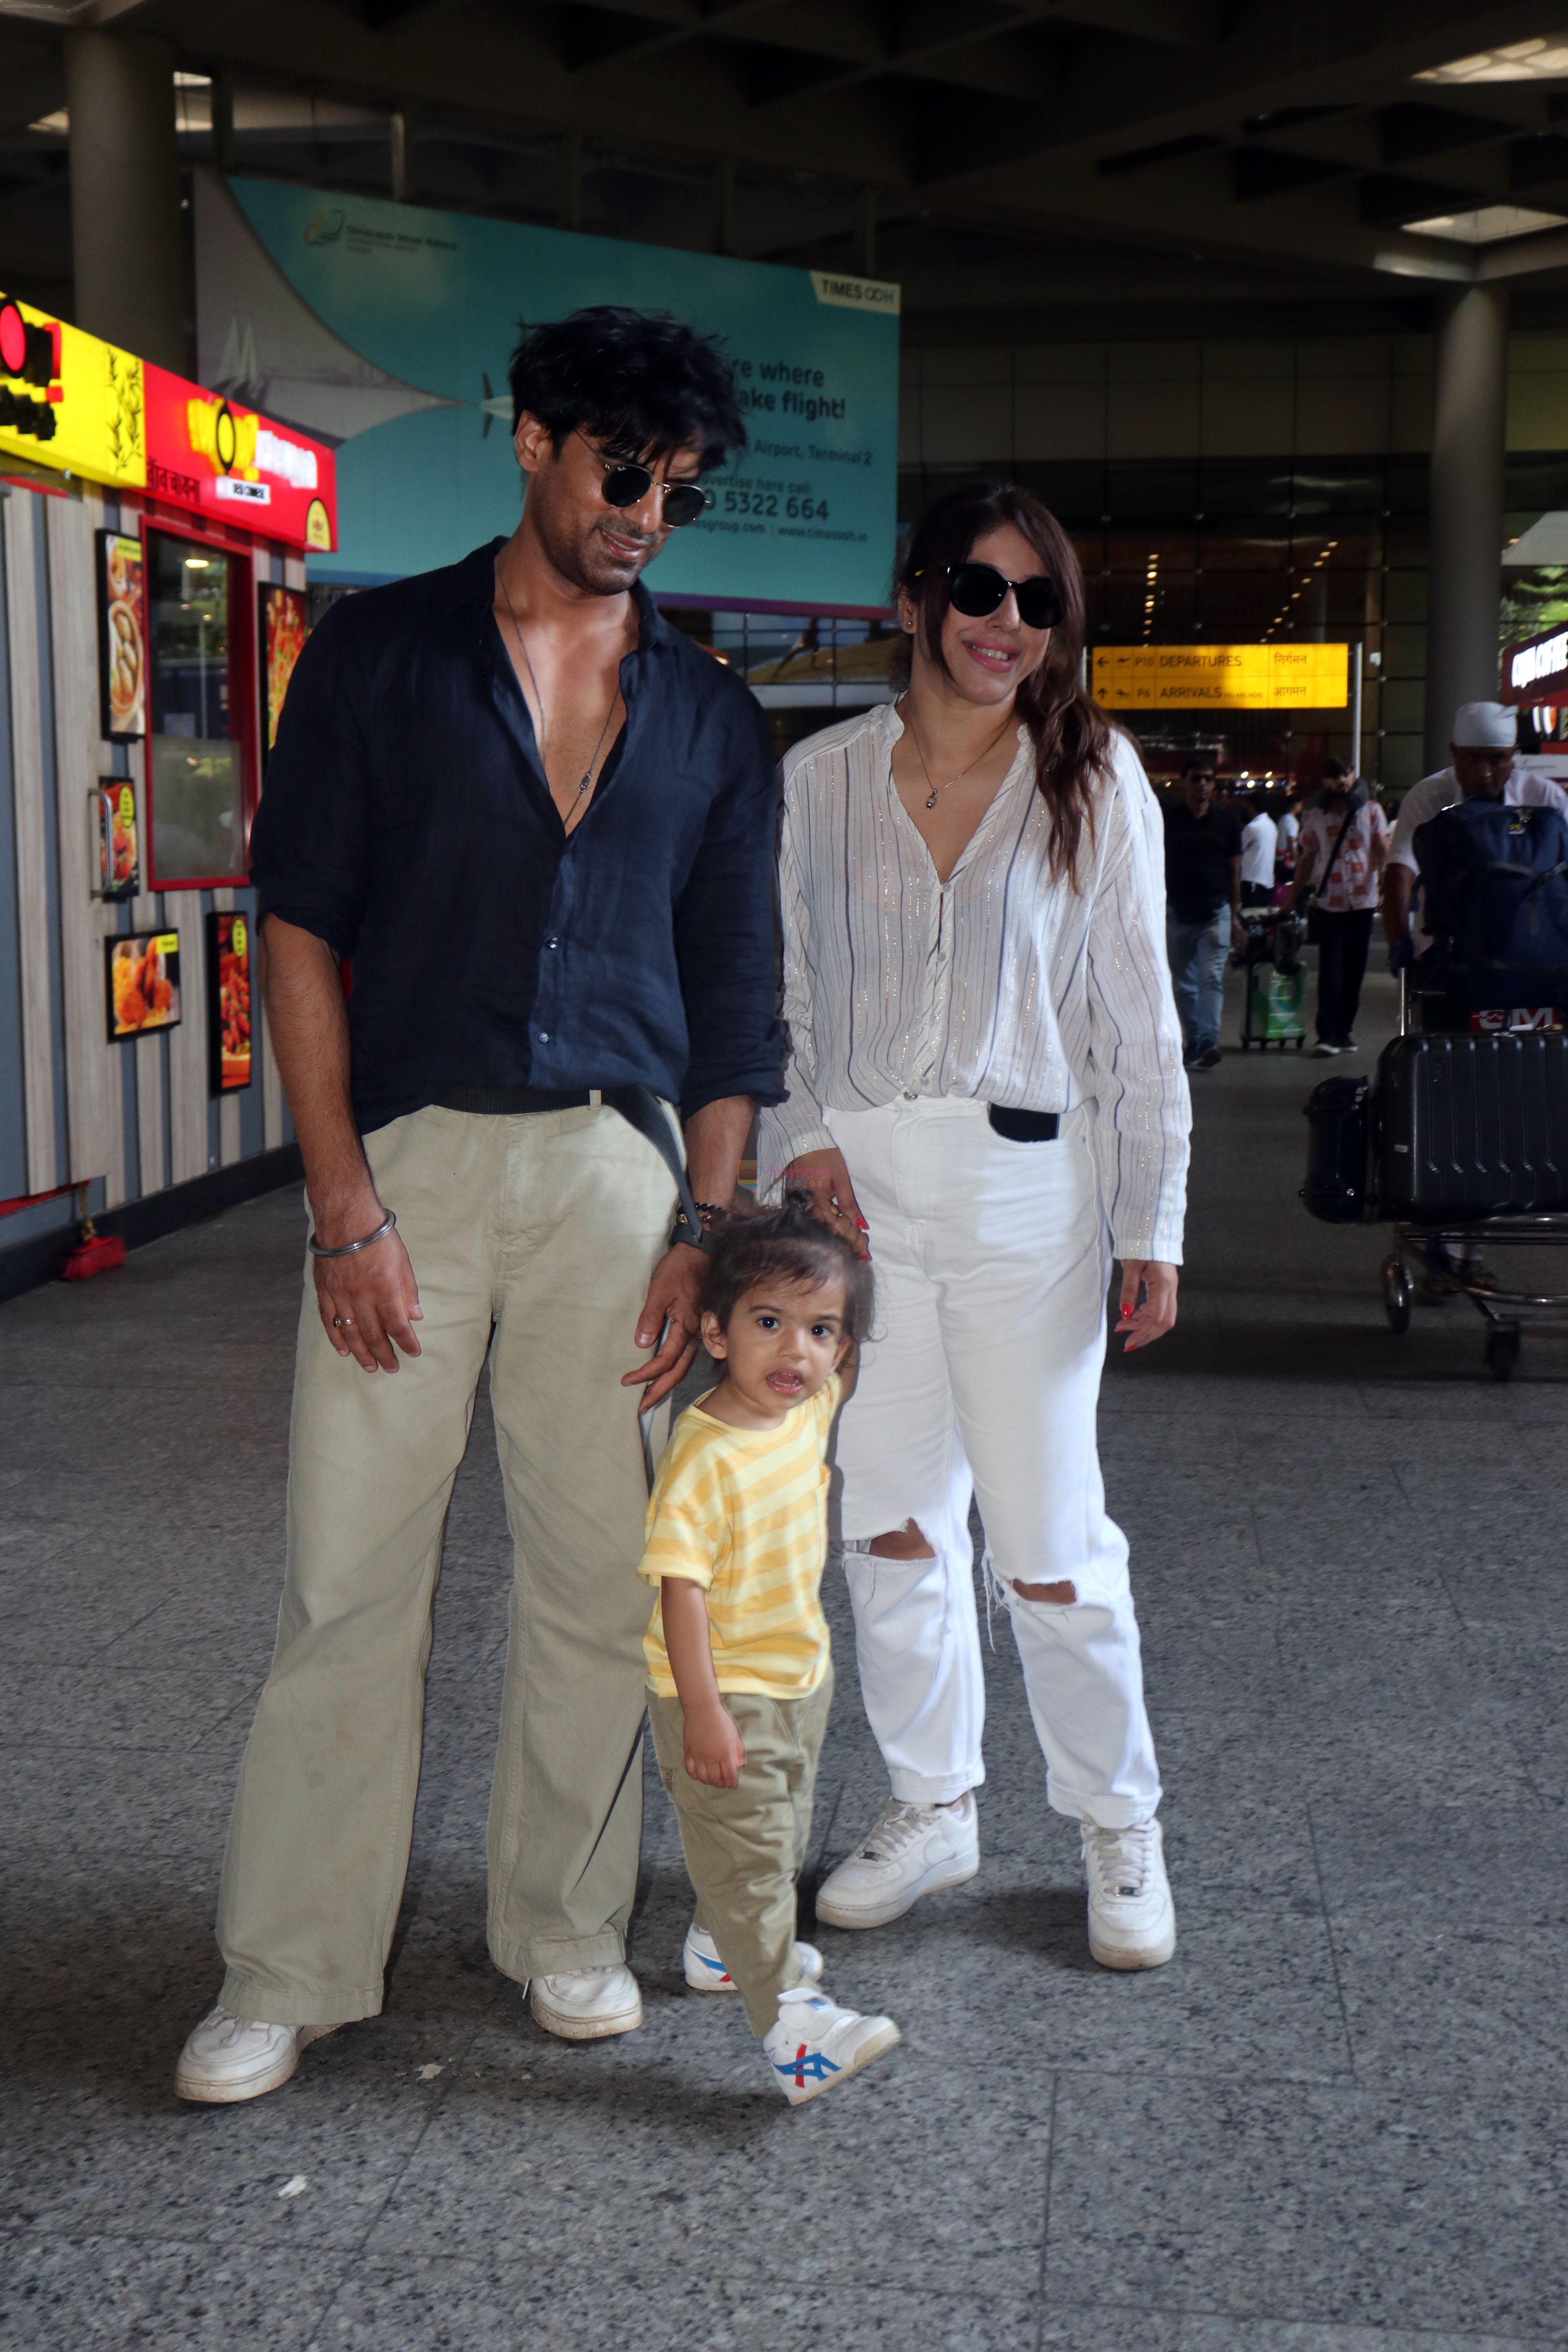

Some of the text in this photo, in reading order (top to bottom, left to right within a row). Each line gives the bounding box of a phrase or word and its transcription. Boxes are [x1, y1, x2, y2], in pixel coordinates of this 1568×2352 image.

[822, 279, 862, 299] TIMES
[760, 359, 824, 387] where
[739, 388, 846, 421] ake flight!
[755, 439, 872, 466] Airport, Terminal 2
[757, 477, 787, 492] here
[725, 490, 778, 516] 5322
[786, 496, 829, 520] 664
[1159, 655, 1242, 667] DEPARTURES
[1274, 652, 1308, 665] निर्गमन
[1160, 686, 1222, 698] ARRIVALS
[1274, 686, 1307, 697] आगमन
